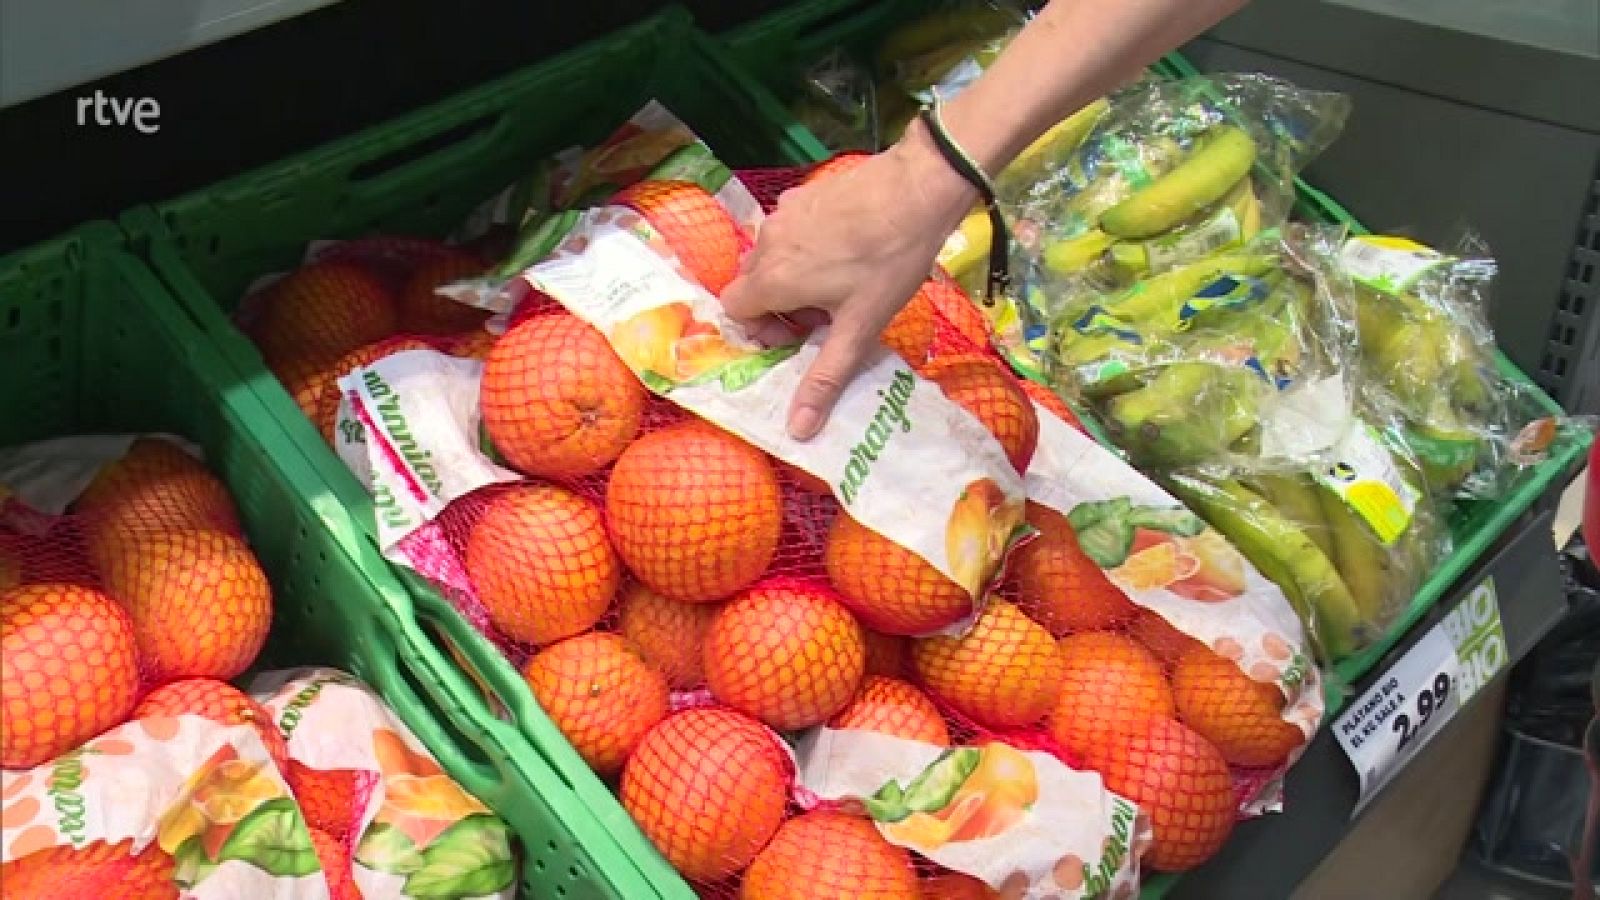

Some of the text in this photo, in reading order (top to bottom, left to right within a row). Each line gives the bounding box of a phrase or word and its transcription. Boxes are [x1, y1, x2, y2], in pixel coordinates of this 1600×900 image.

[839, 369, 916, 505] naranjas
[1443, 584, 1498, 650] BIO
[1457, 634, 1502, 706] BIO
